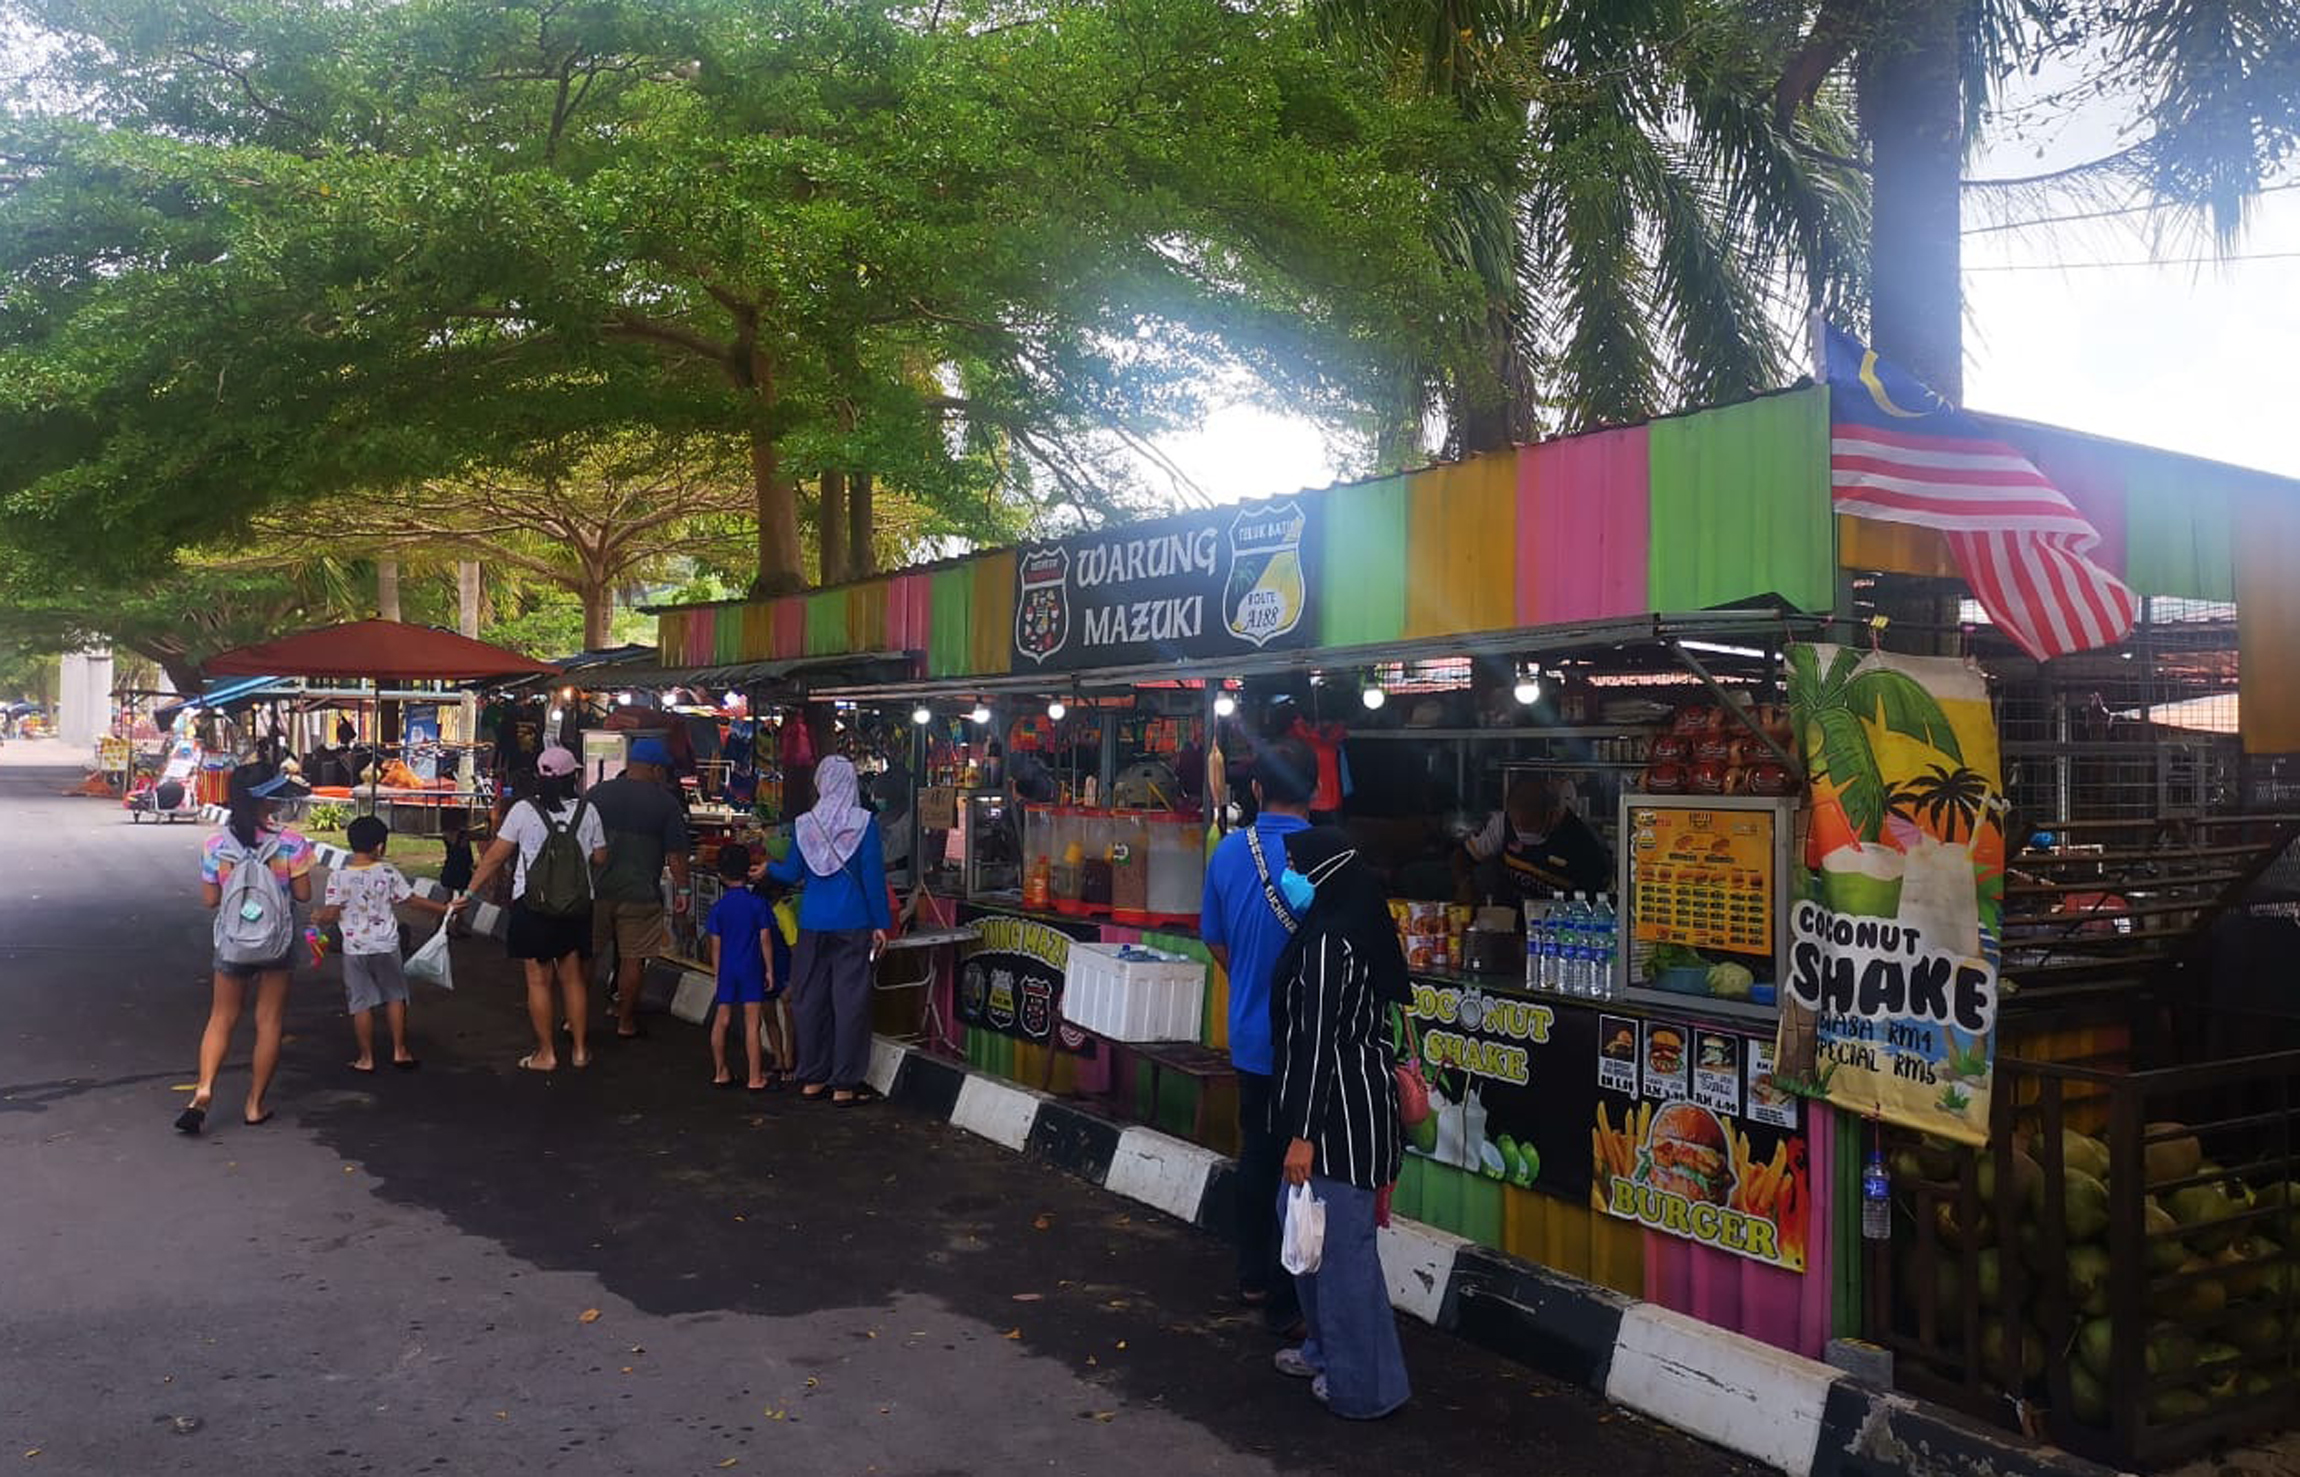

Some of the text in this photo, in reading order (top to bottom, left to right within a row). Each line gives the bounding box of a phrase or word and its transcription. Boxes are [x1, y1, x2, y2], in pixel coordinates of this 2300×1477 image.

[1076, 528, 1218, 588] WARUNG
[1083, 595, 1204, 647] MAZUKI
[1800, 906, 1920, 955] COCONUT
[1793, 942, 1988, 1030] SHAKE
[1427, 1031, 1529, 1083] SHAKE
[1893, 1052, 1937, 1086] RM5
[1611, 1178, 1779, 1260] BURGER
